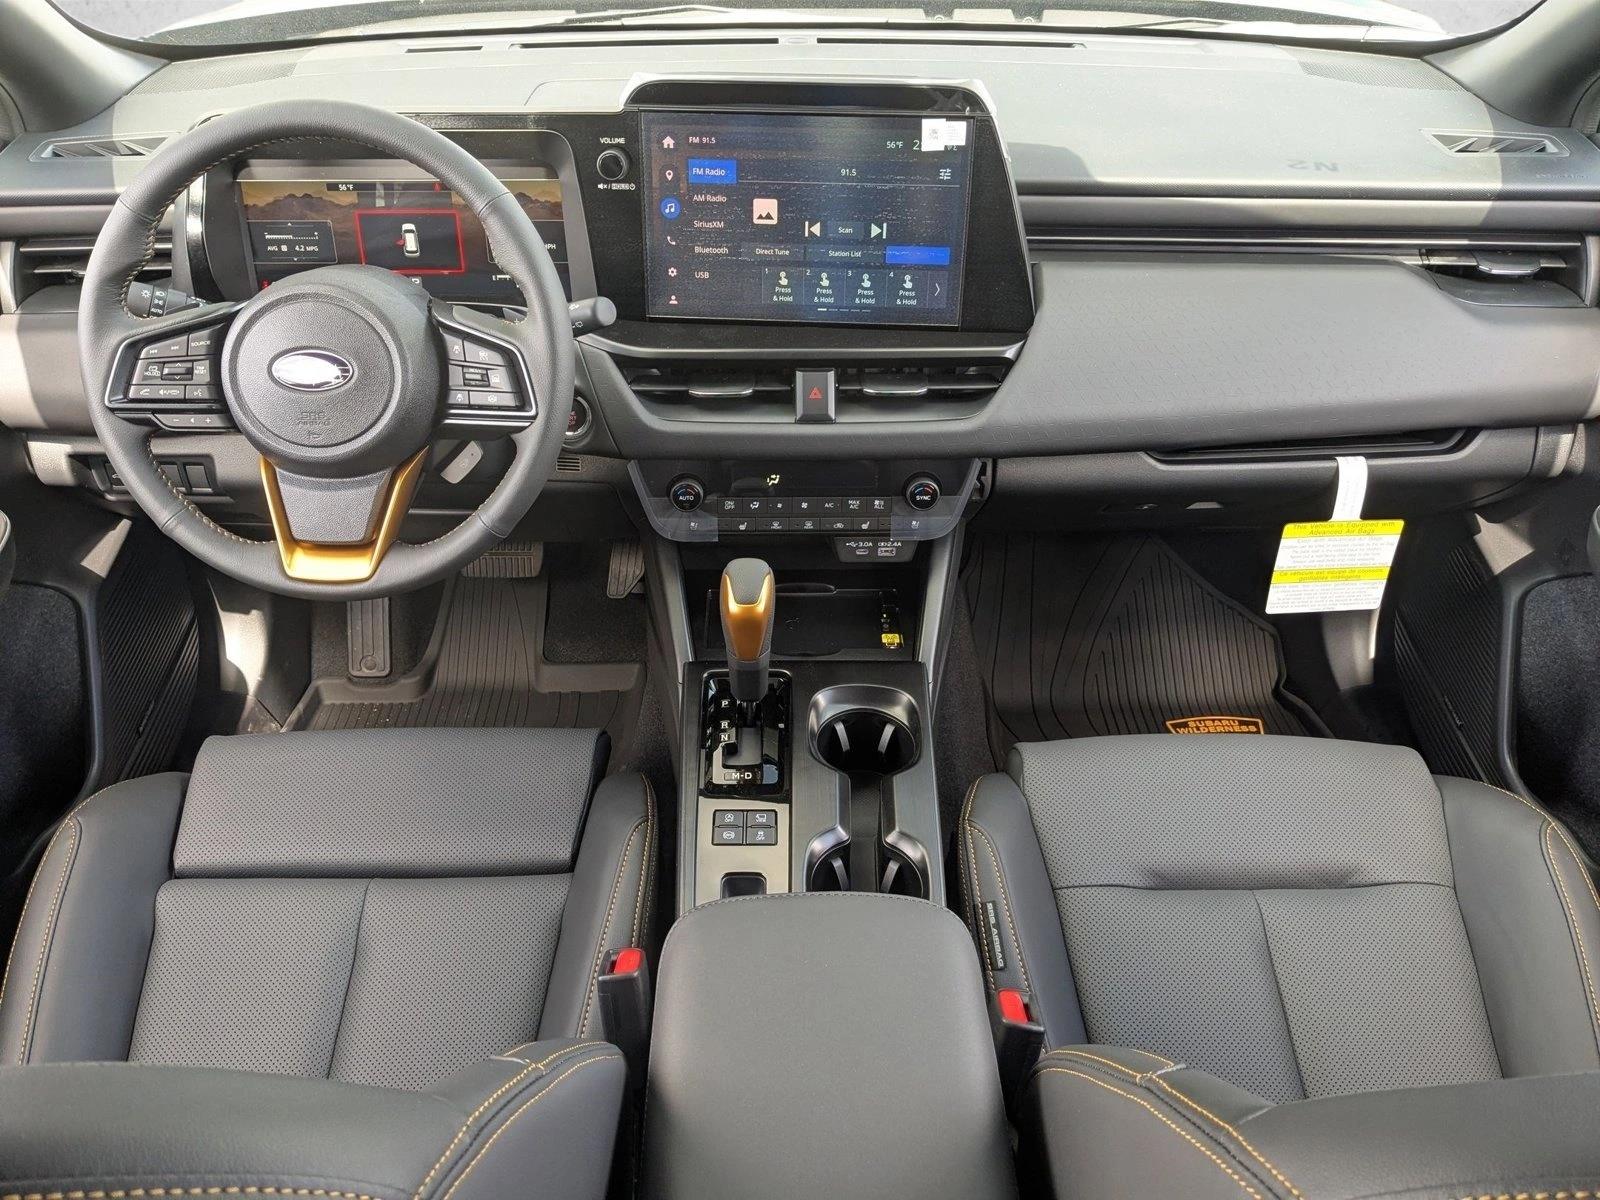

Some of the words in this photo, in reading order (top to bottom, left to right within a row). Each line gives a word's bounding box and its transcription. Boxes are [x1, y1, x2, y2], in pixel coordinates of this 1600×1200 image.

[692, 168, 704, 176] FM
[841, 168, 856, 176] 91.5
[694, 246, 728, 254] Bluetooth
[1176, 725, 1257, 734] WILDERNESS
